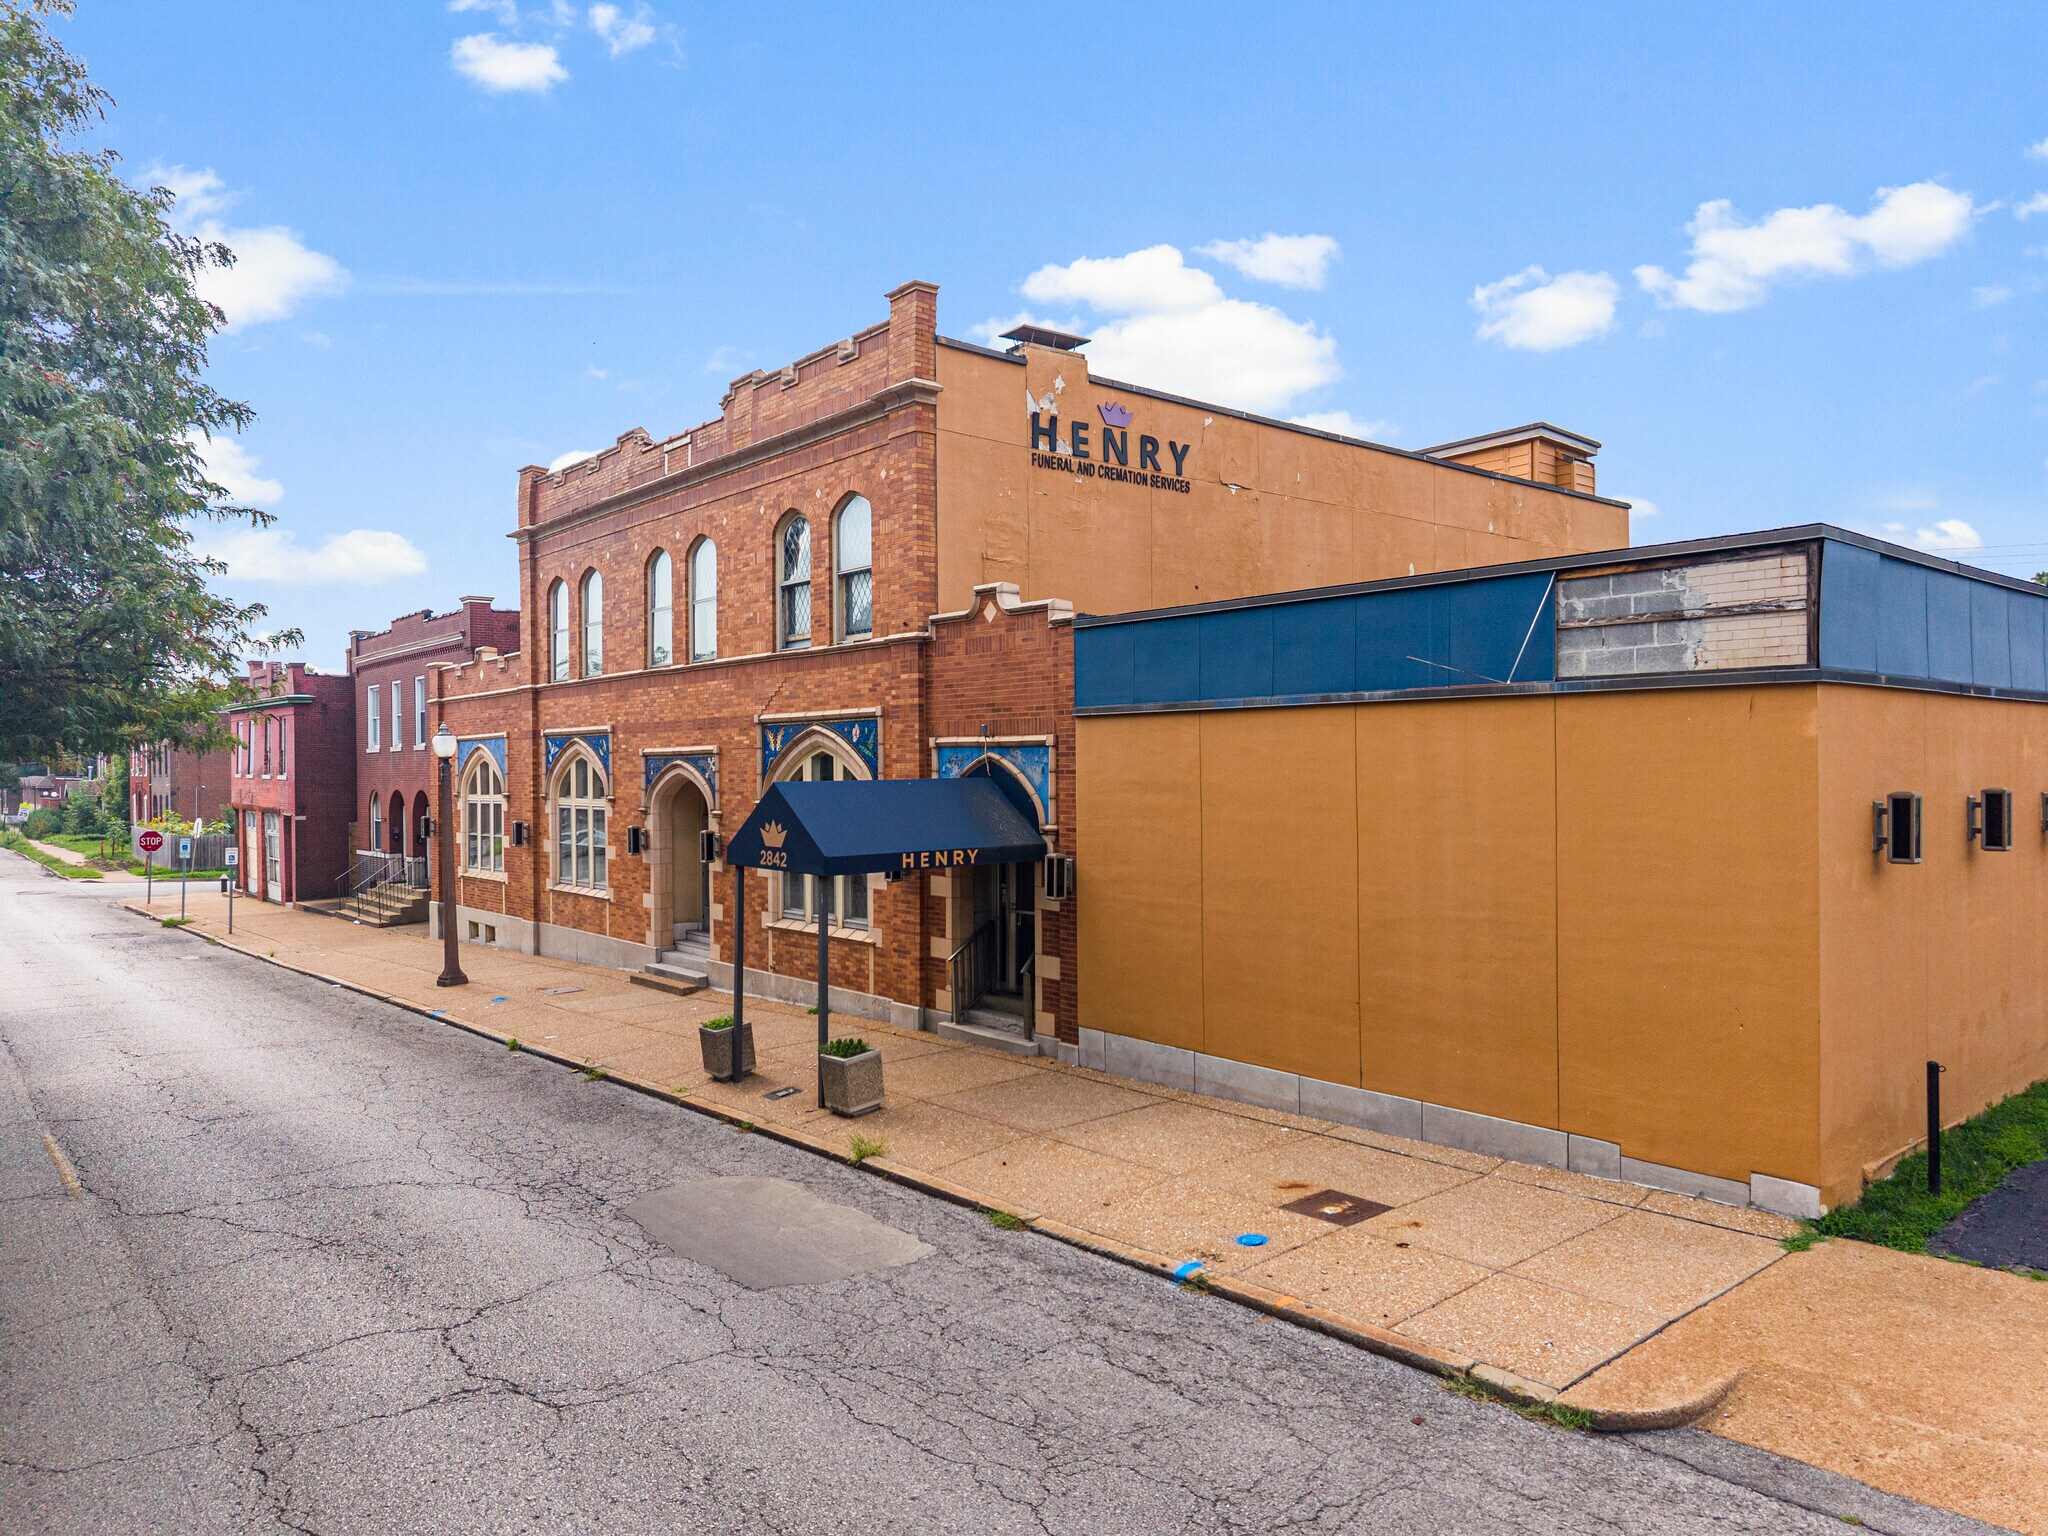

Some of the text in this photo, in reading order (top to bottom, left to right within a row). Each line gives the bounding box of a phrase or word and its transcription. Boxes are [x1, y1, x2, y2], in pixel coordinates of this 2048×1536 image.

[1031, 411, 1190, 476] HENRY
[1031, 452, 1190, 494] FUNERAL AND CREMATION SERVICES
[140, 837, 162, 846] STOP
[759, 849, 787, 868] 2842
[902, 849, 979, 869] HENRY
